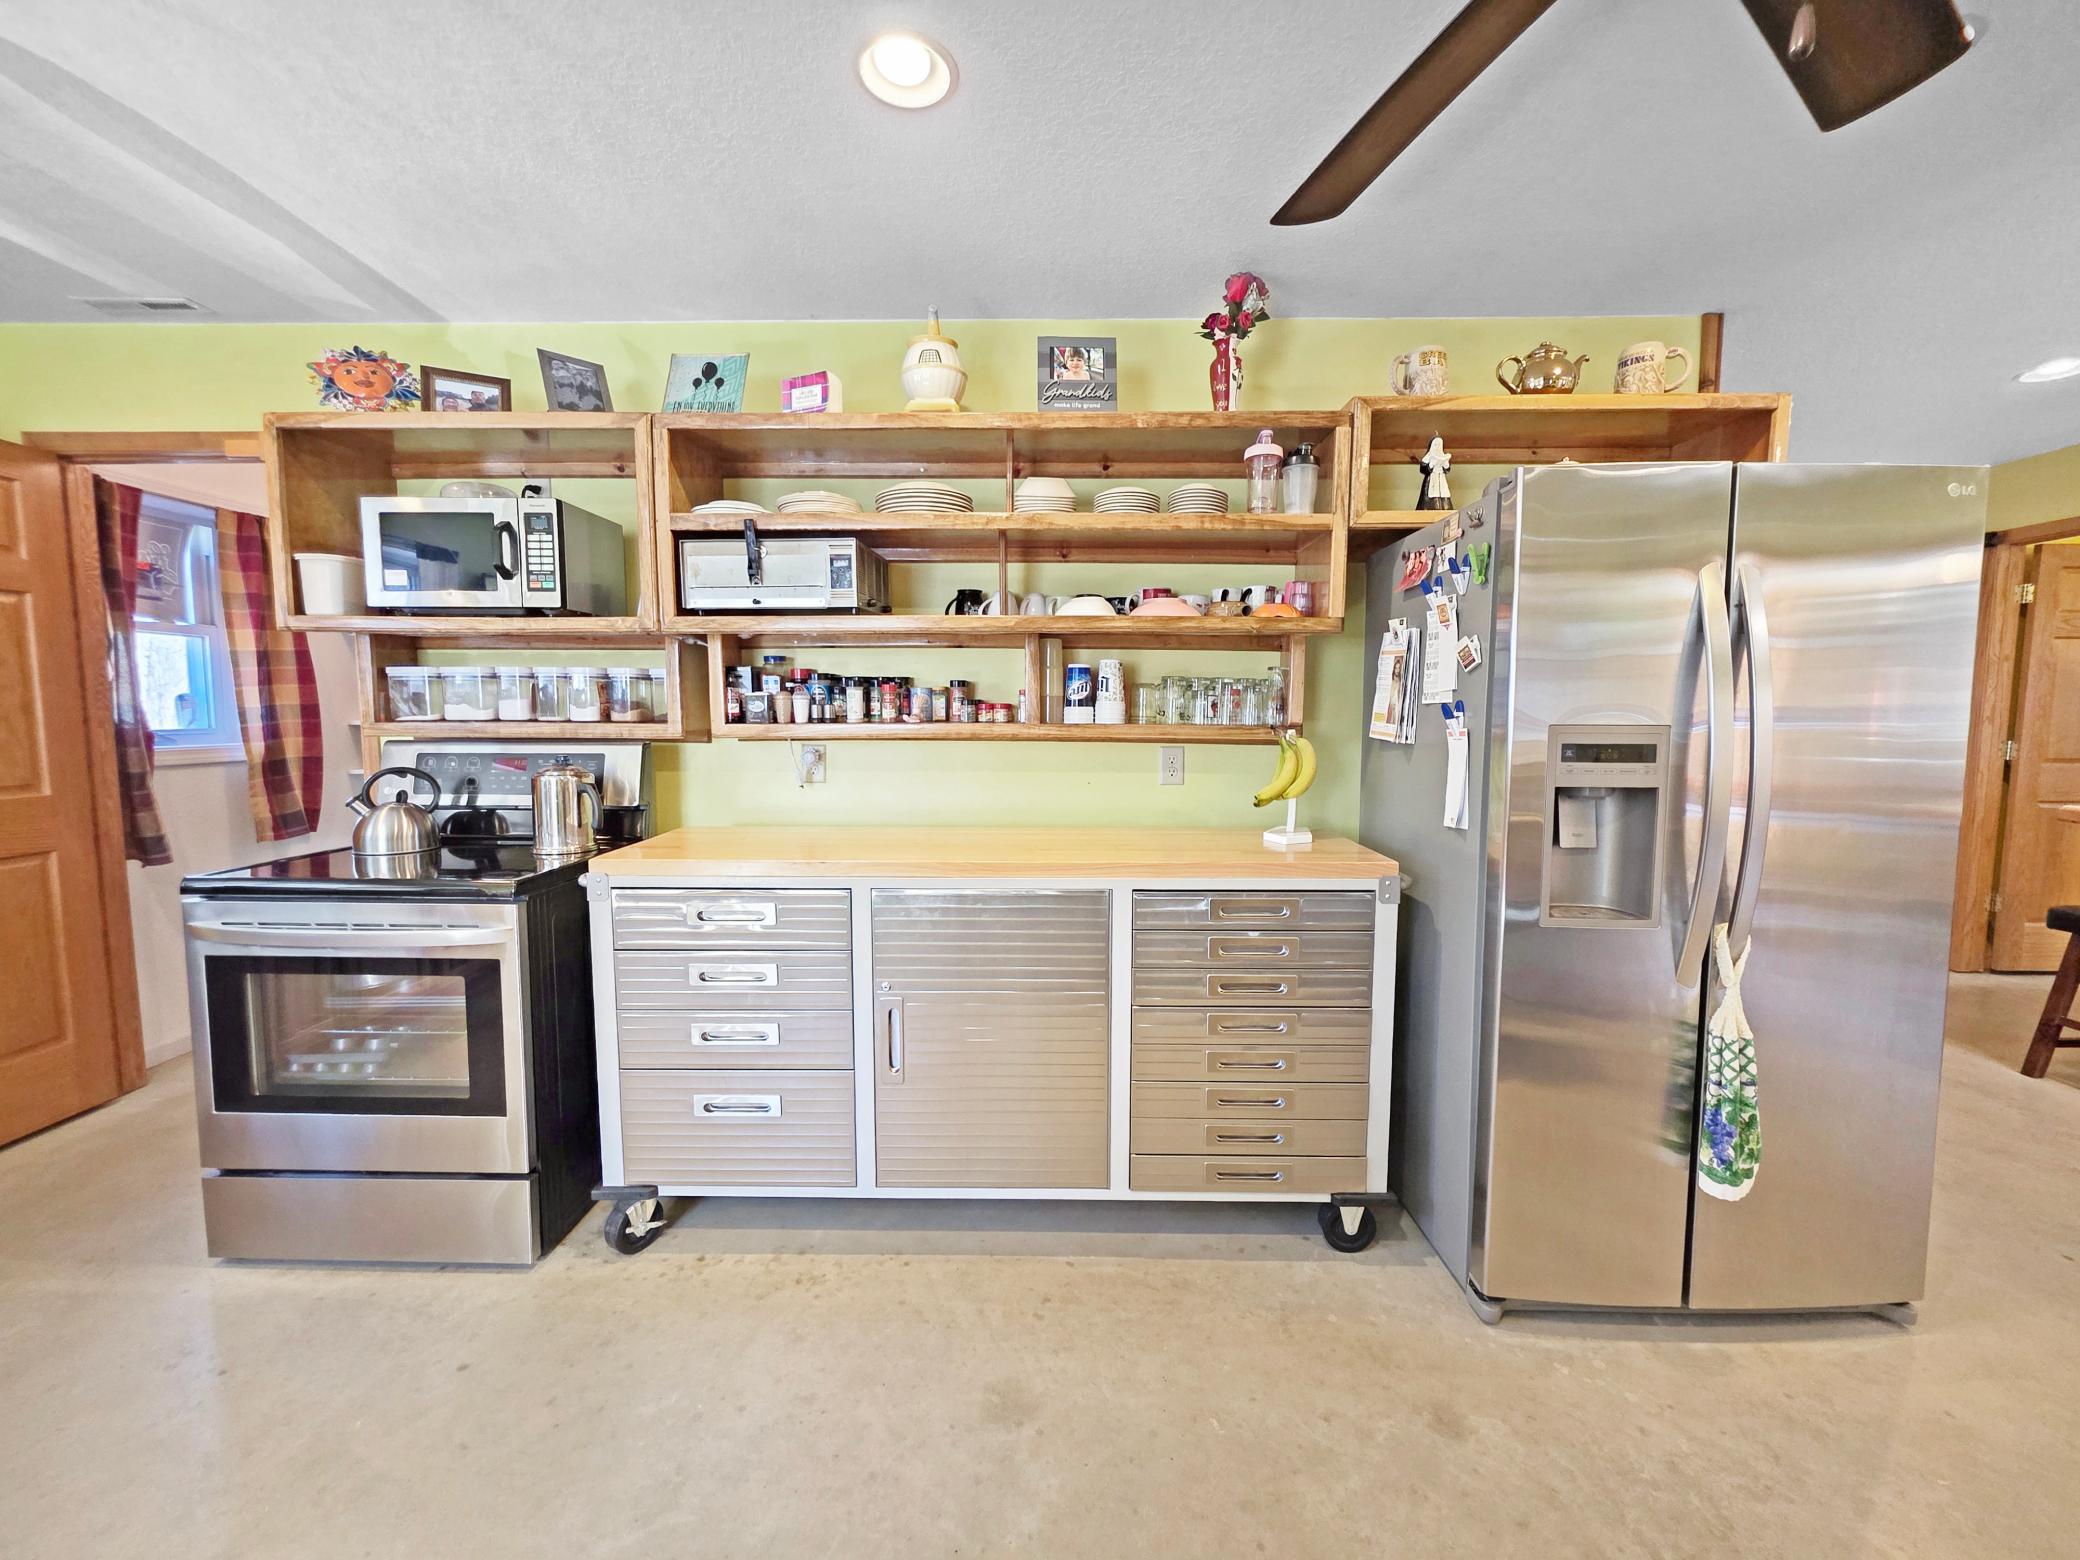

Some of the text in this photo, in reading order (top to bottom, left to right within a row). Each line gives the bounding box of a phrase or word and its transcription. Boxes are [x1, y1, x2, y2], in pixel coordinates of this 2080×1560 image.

[1617, 353, 1655, 371] VIKINGS
[1042, 379, 1112, 404] Grandkids
[1961, 485, 1977, 496] LG
